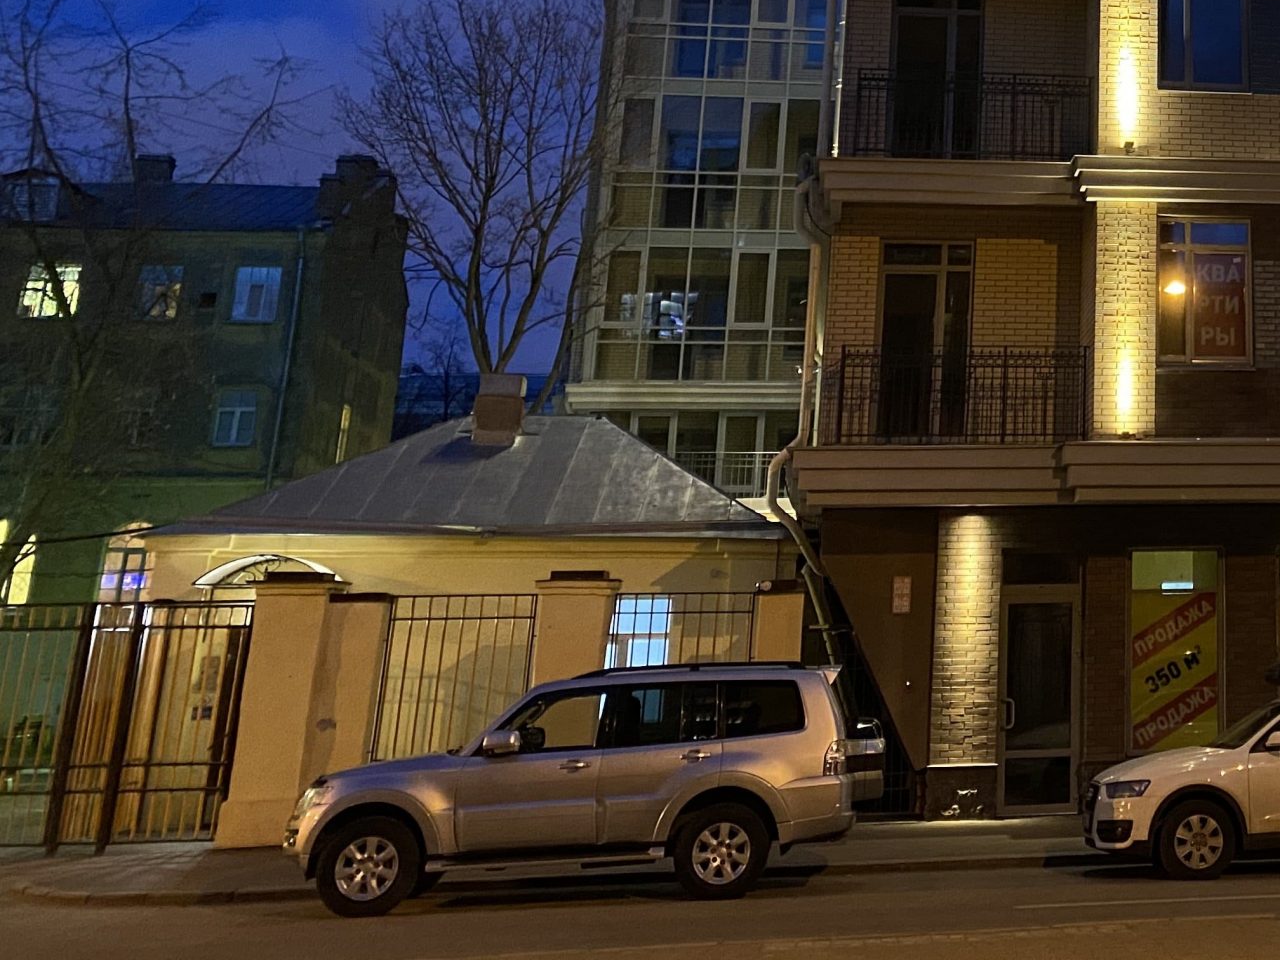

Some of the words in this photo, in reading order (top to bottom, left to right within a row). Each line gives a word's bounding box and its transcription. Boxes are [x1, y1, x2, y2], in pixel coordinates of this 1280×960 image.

[1197, 263, 1240, 282] КВА
[1201, 326, 1236, 347] РЫ
[1134, 599, 1214, 657] ПРОДАЖА
[1145, 661, 1181, 693] 350
[1134, 686, 1216, 747] ПРОДАЖА
